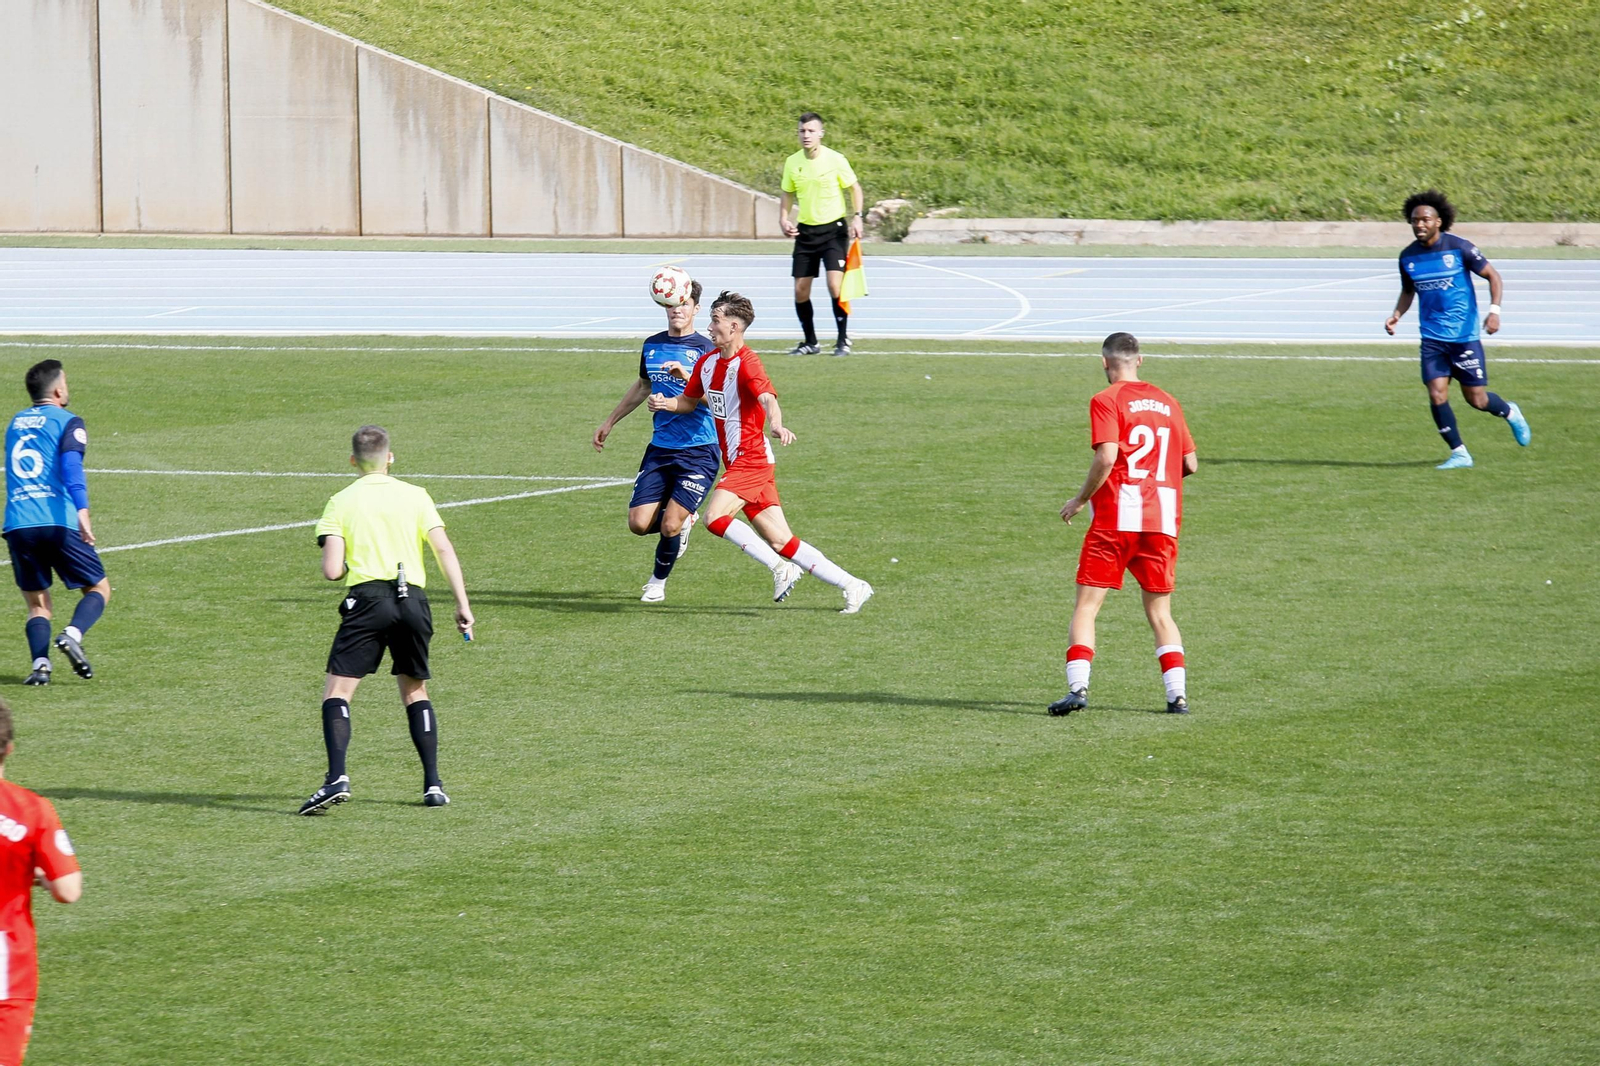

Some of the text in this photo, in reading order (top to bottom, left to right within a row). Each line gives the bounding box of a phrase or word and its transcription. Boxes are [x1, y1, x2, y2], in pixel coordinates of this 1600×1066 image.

[1128, 399, 1171, 417] JOSEMA
[11, 433, 44, 479] 6
[1127, 424, 1171, 482] 21
